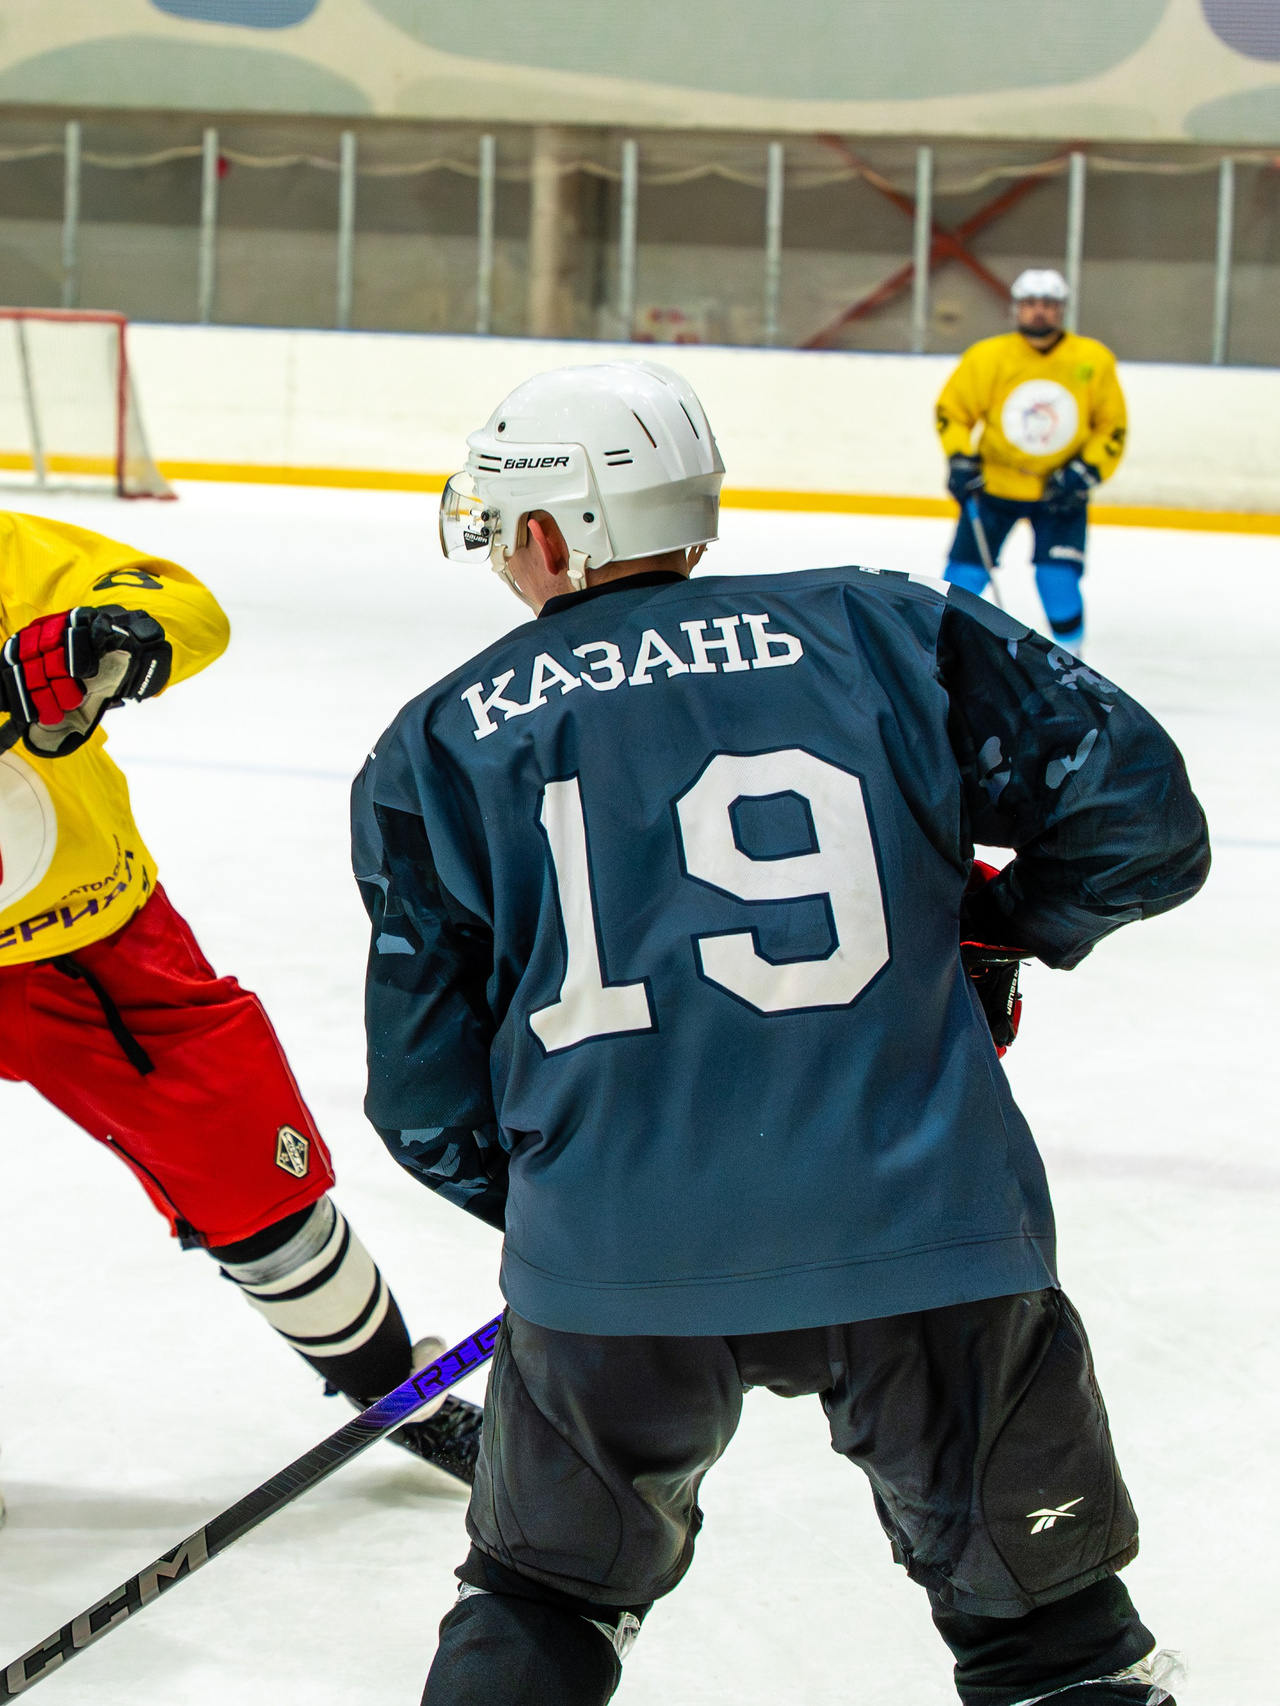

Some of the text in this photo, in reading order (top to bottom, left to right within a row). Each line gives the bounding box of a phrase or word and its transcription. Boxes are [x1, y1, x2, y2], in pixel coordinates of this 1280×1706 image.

[504, 457, 569, 469] BAUER
[461, 613, 803, 741] КАЗАНЬ
[528, 747, 890, 1055] 19
[7, 1526, 209, 1694] CCM
